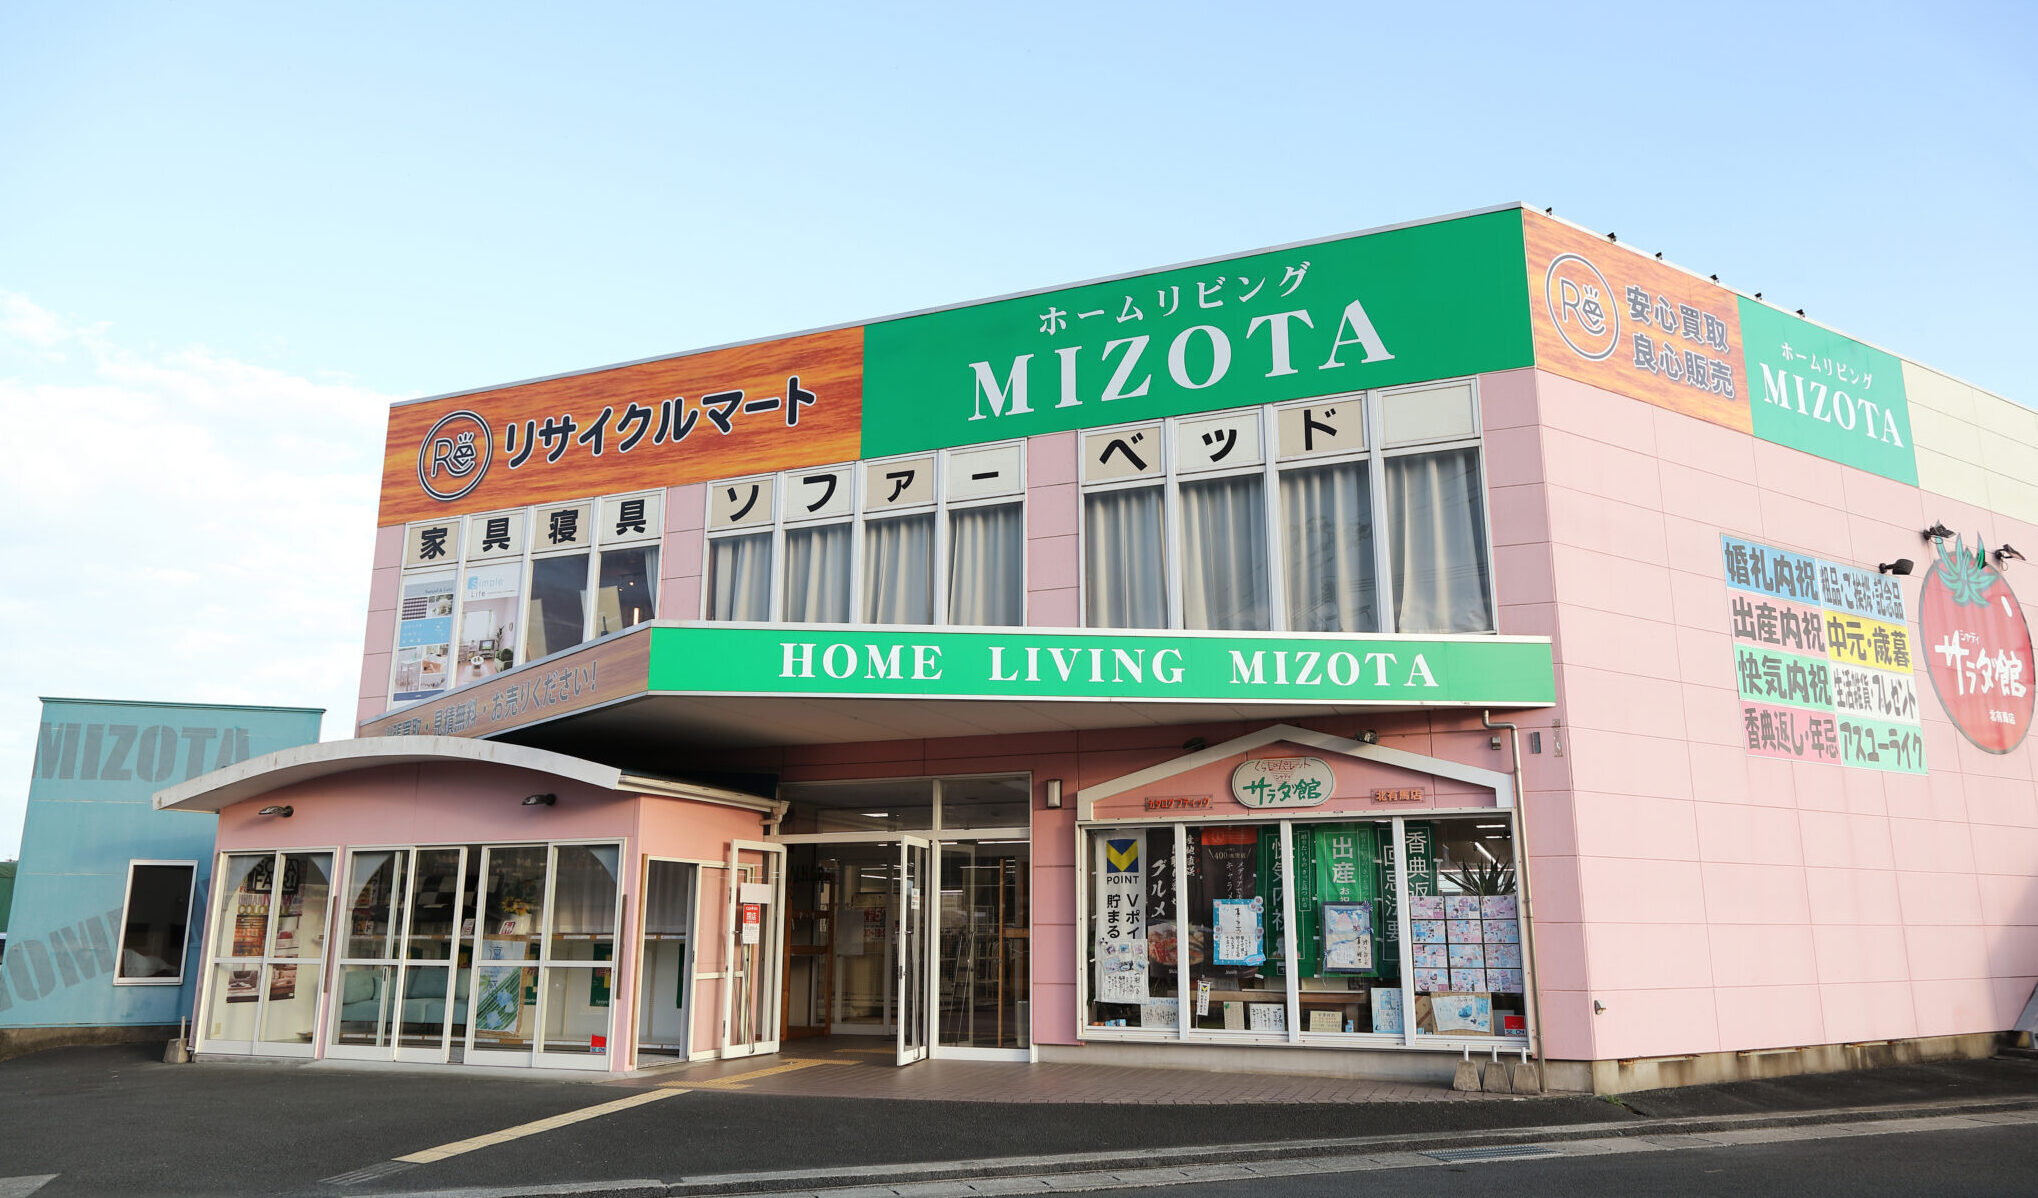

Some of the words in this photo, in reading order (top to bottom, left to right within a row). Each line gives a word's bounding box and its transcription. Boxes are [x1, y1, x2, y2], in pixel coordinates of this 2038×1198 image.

[1038, 260, 1311, 336] ホームリビング
[1625, 284, 1729, 353] 安心買取
[967, 299, 1395, 421] MIZOTA
[1632, 332, 1735, 399] 良心販売
[1781, 341, 1873, 390] ホームリビング
[505, 375, 816, 469] リサイクルマート
[1759, 362, 1904, 448] MIZOTA
[419, 499, 647, 561] 家具寝具
[1724, 541, 1818, 601] 婚礼内祝
[1732, 594, 1825, 653] 出産内祝
[1826, 615, 1910, 669] 中元・歳暮
[779, 642, 943, 682] HOME
[989, 646, 1186, 684] LIVING
[1229, 650, 1440, 688] MIZOTA
[1738, 649, 1832, 706] 快気内祝
[1934, 629, 2027, 698] サラダ館
[1744, 707, 1839, 760] 香典返し・年忌
[1839, 721, 1923, 770] アズユーライク
[1243, 776, 1322, 806] サラダ館
[1107, 875, 1140, 885] POINT
[1151, 858, 1167, 918] グルメ
[1332, 836, 1356, 884] 出産
[1106, 894, 1121, 939] 貯まる
